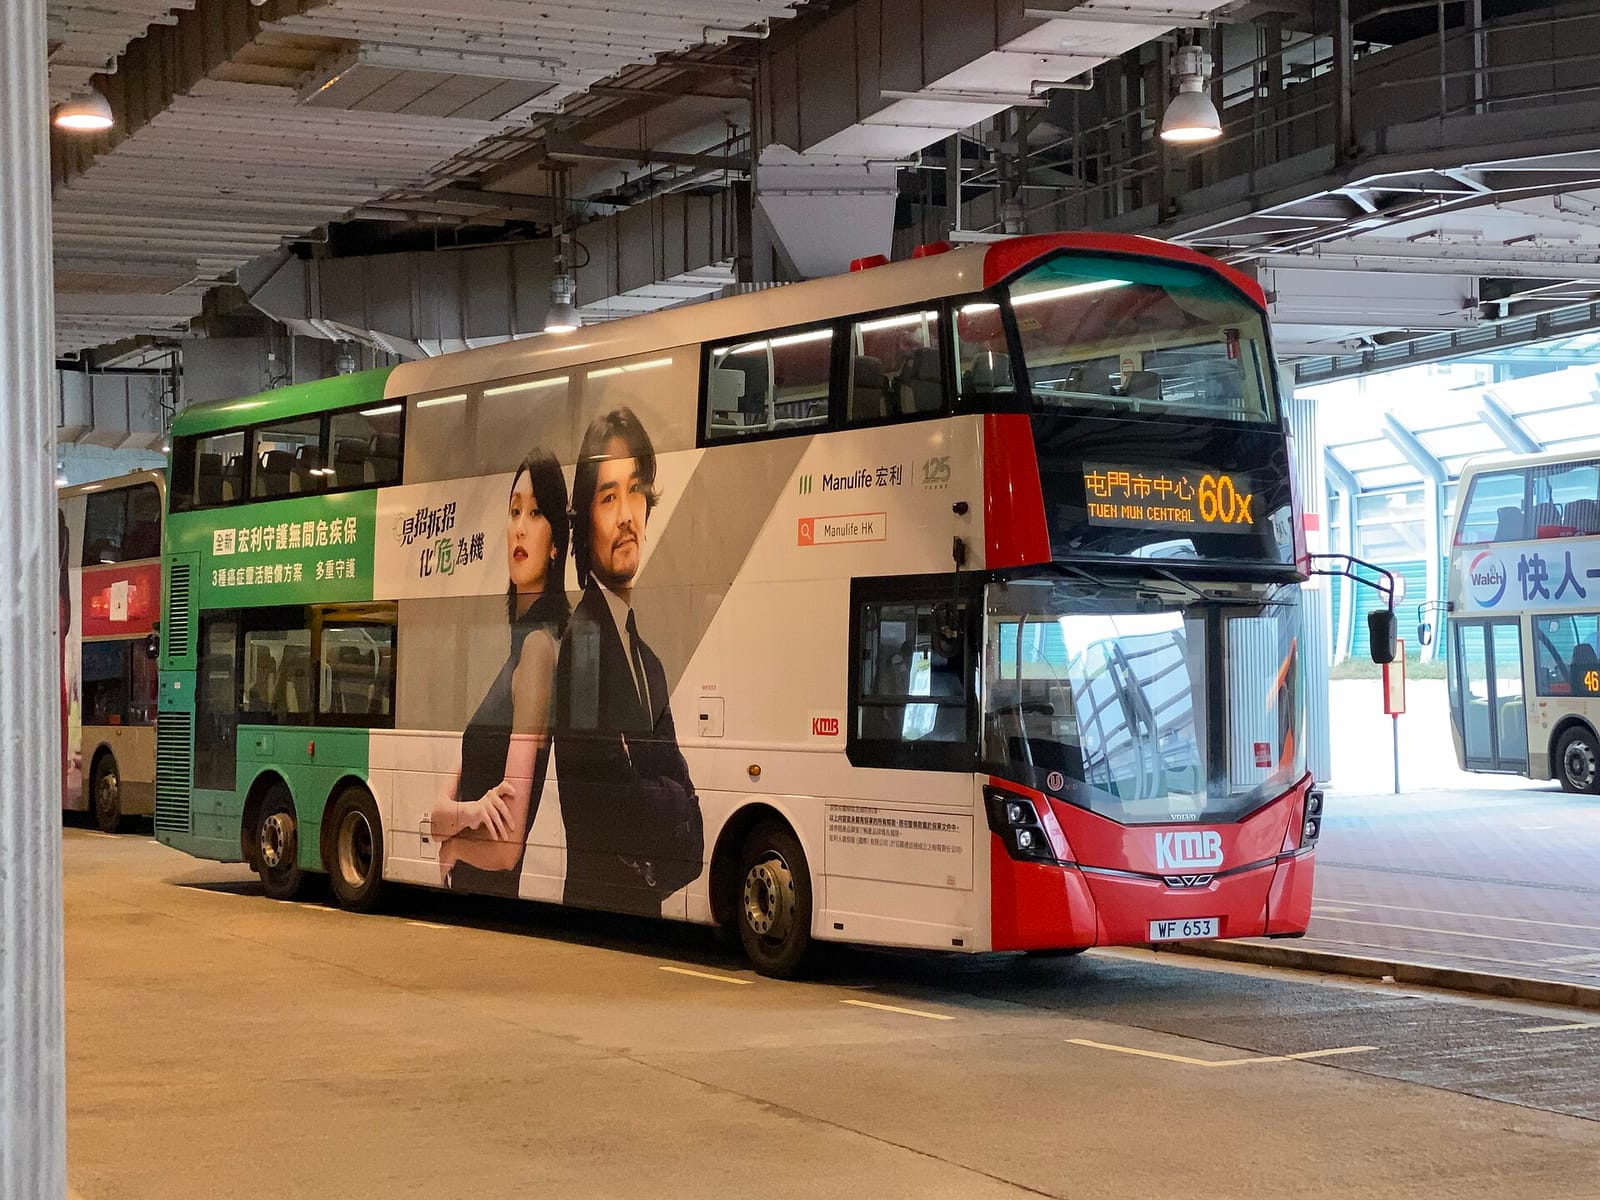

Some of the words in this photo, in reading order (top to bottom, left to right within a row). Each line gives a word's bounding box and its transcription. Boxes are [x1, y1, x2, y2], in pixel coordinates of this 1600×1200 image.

[822, 468, 872, 492] Manulife
[875, 464, 902, 487] 宏利
[921, 456, 951, 484] 125
[1084, 470, 1195, 501] 屯門市中心
[400, 501, 457, 548] 見招拆招
[1088, 503, 1118, 519] TUEN
[1121, 505, 1143, 520] MUN
[1146, 506, 1195, 523] CENTRAL
[238, 516, 357, 553] 宏利守護無間危疾保
[824, 523, 858, 537] Manulife
[861, 522, 874, 535] HK
[315, 558, 356, 581] 多重守護
[1471, 573, 1503, 587] Walch
[1584, 671, 1599, 692] 46
[812, 717, 839, 736] KMB
[1155, 831, 1224, 869] KMB
[1158, 922, 1177, 938] WF
[1183, 920, 1211, 936] 653
